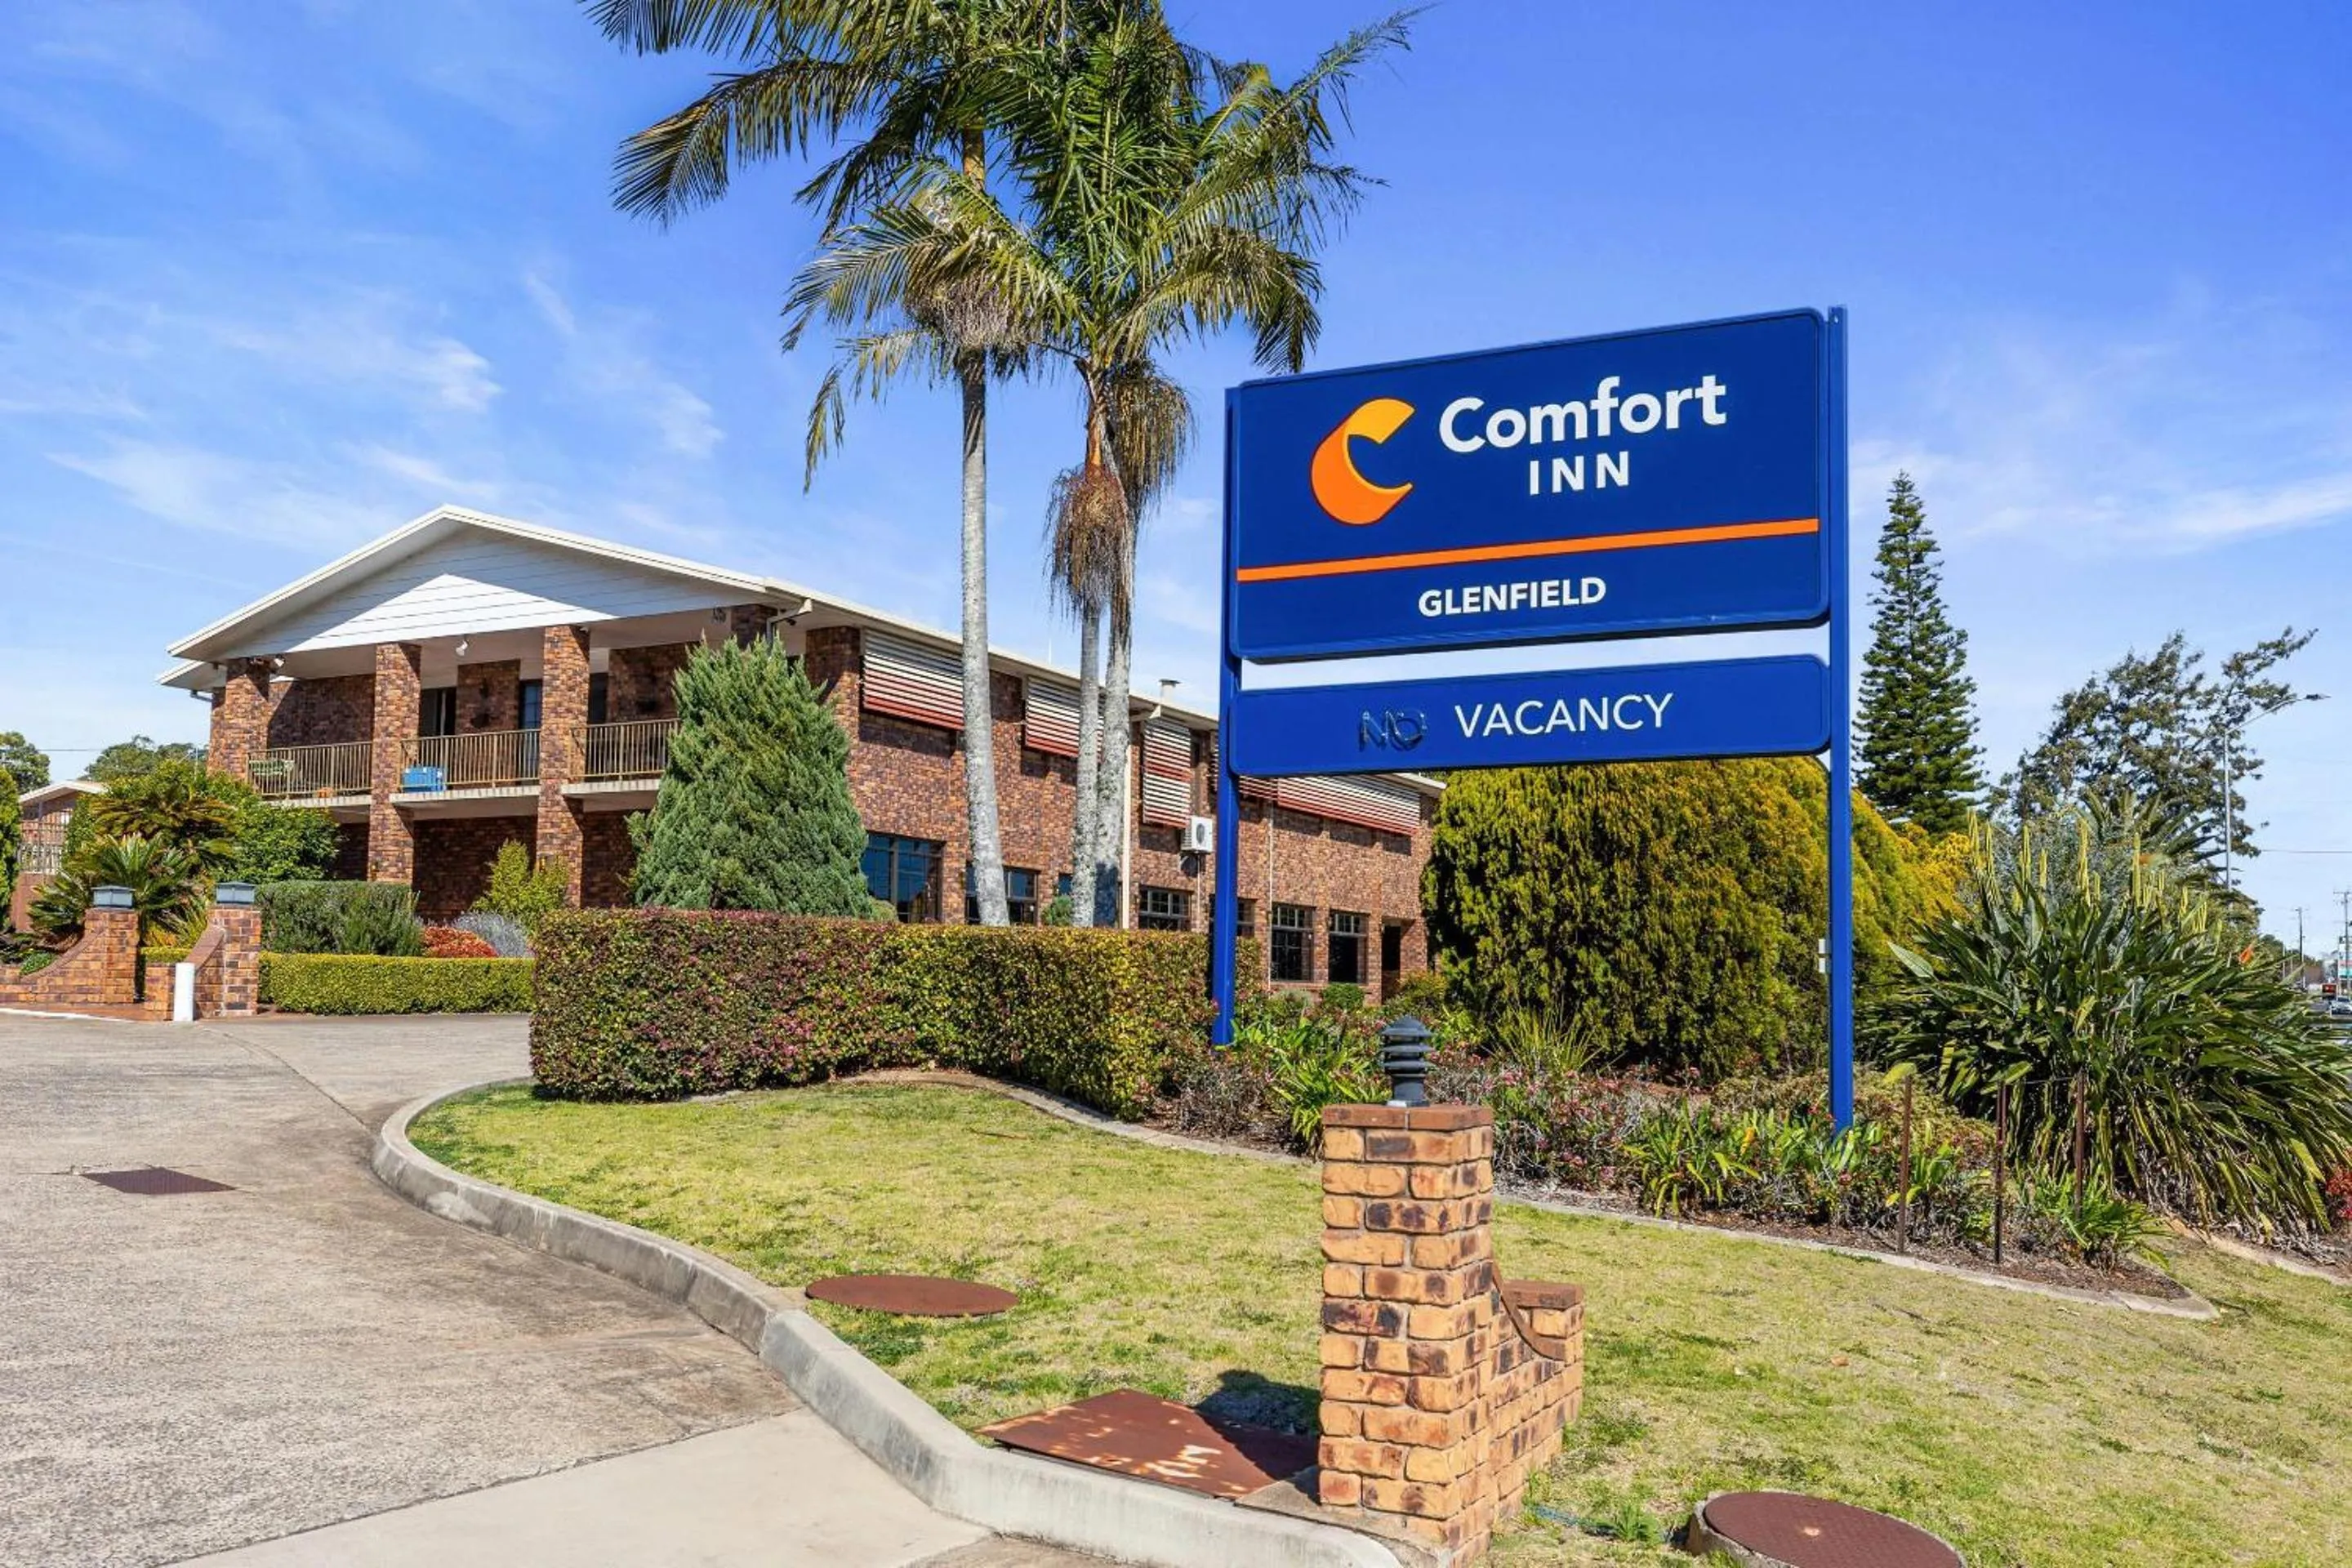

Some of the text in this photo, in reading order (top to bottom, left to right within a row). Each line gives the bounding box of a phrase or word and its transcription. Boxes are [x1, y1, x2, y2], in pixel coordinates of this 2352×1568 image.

[1439, 375, 1726, 452] Comfort
[1530, 451, 1628, 495] INN
[1419, 577, 1606, 617] GLENFIELD
[1359, 693, 1673, 752] NO VACANCY
